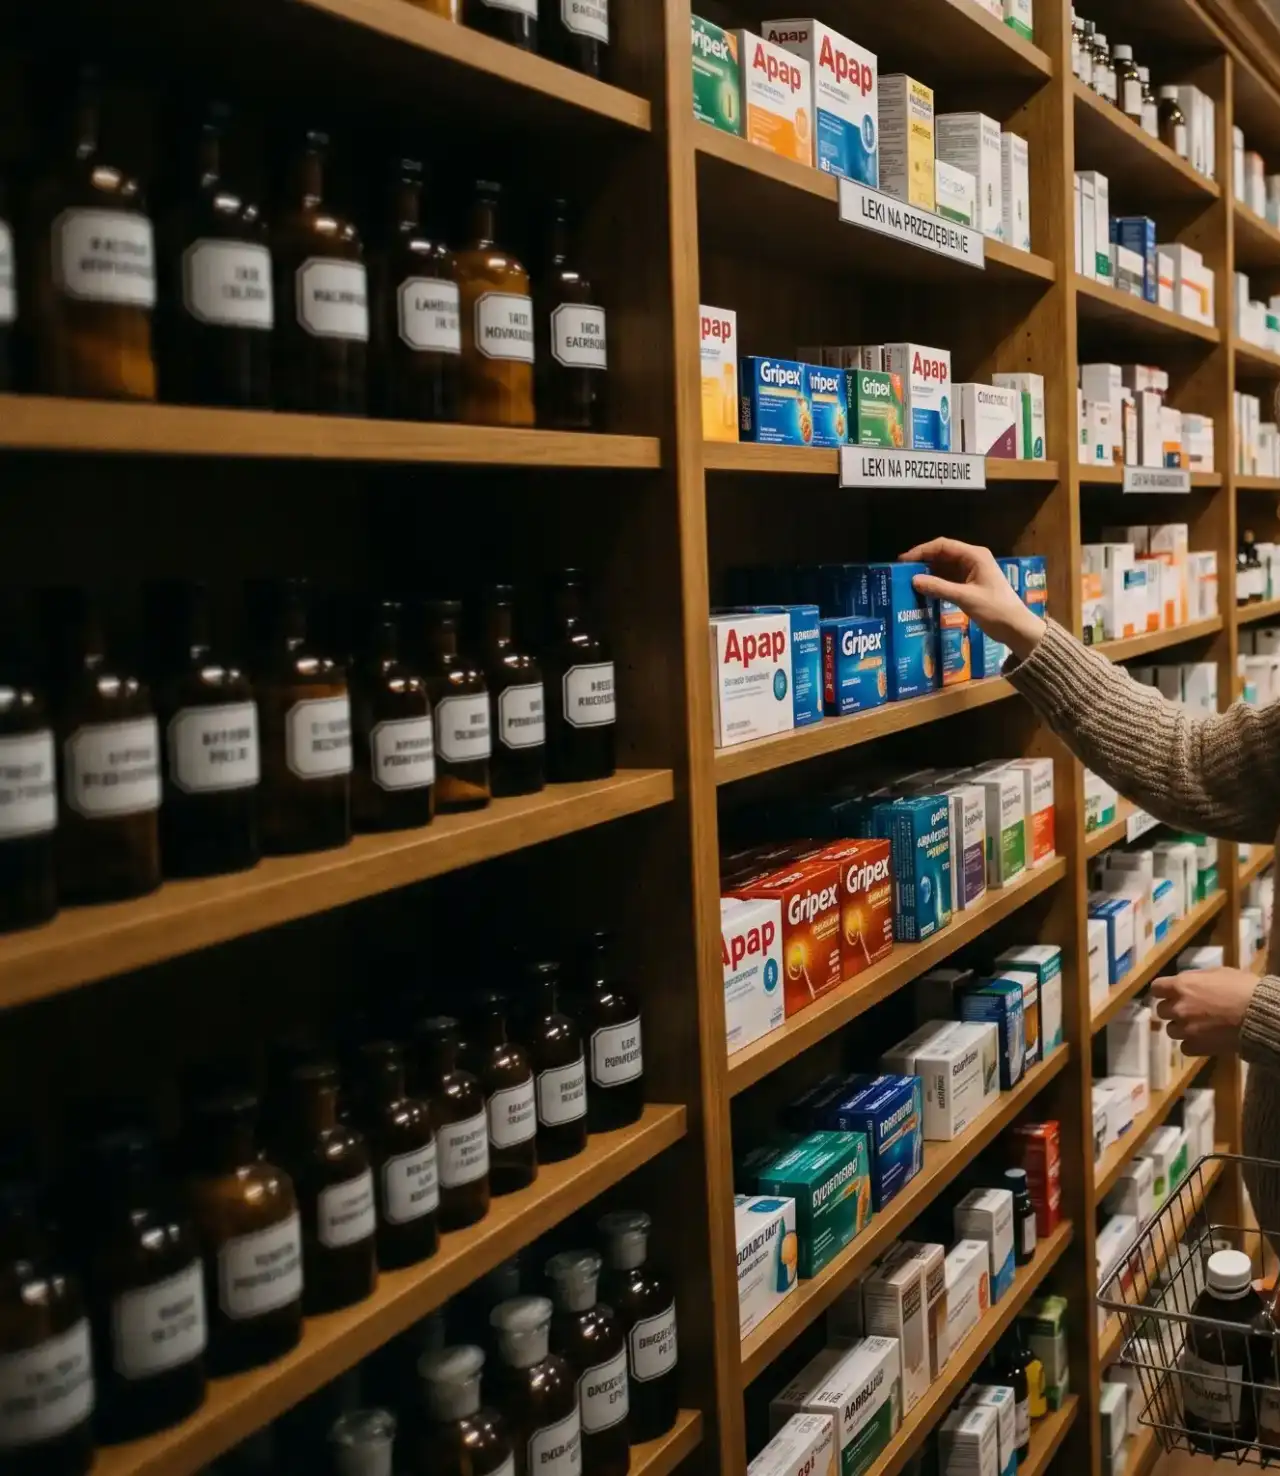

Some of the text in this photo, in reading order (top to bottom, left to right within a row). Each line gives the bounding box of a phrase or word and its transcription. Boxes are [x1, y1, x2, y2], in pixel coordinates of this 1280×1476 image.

[691, 22, 729, 62] ripex
[767, 30, 808, 45] Apap
[752, 42, 802, 93] Apap
[818, 34, 873, 97] Apap
[861, 196, 969, 254] LEKI NA PRZEZIĘBIENIE
[701, 317, 731, 344] pap
[760, 361, 800, 387] Gripex
[912, 351, 947, 384] Apap
[862, 457, 971, 485] LEKI NA PRZEZIĘBIENIE
[723, 628, 785, 668] Apap
[841, 629, 882, 659] Gripex
[846, 855, 890, 894] Gripex
[788, 883, 838, 926] Gripex
